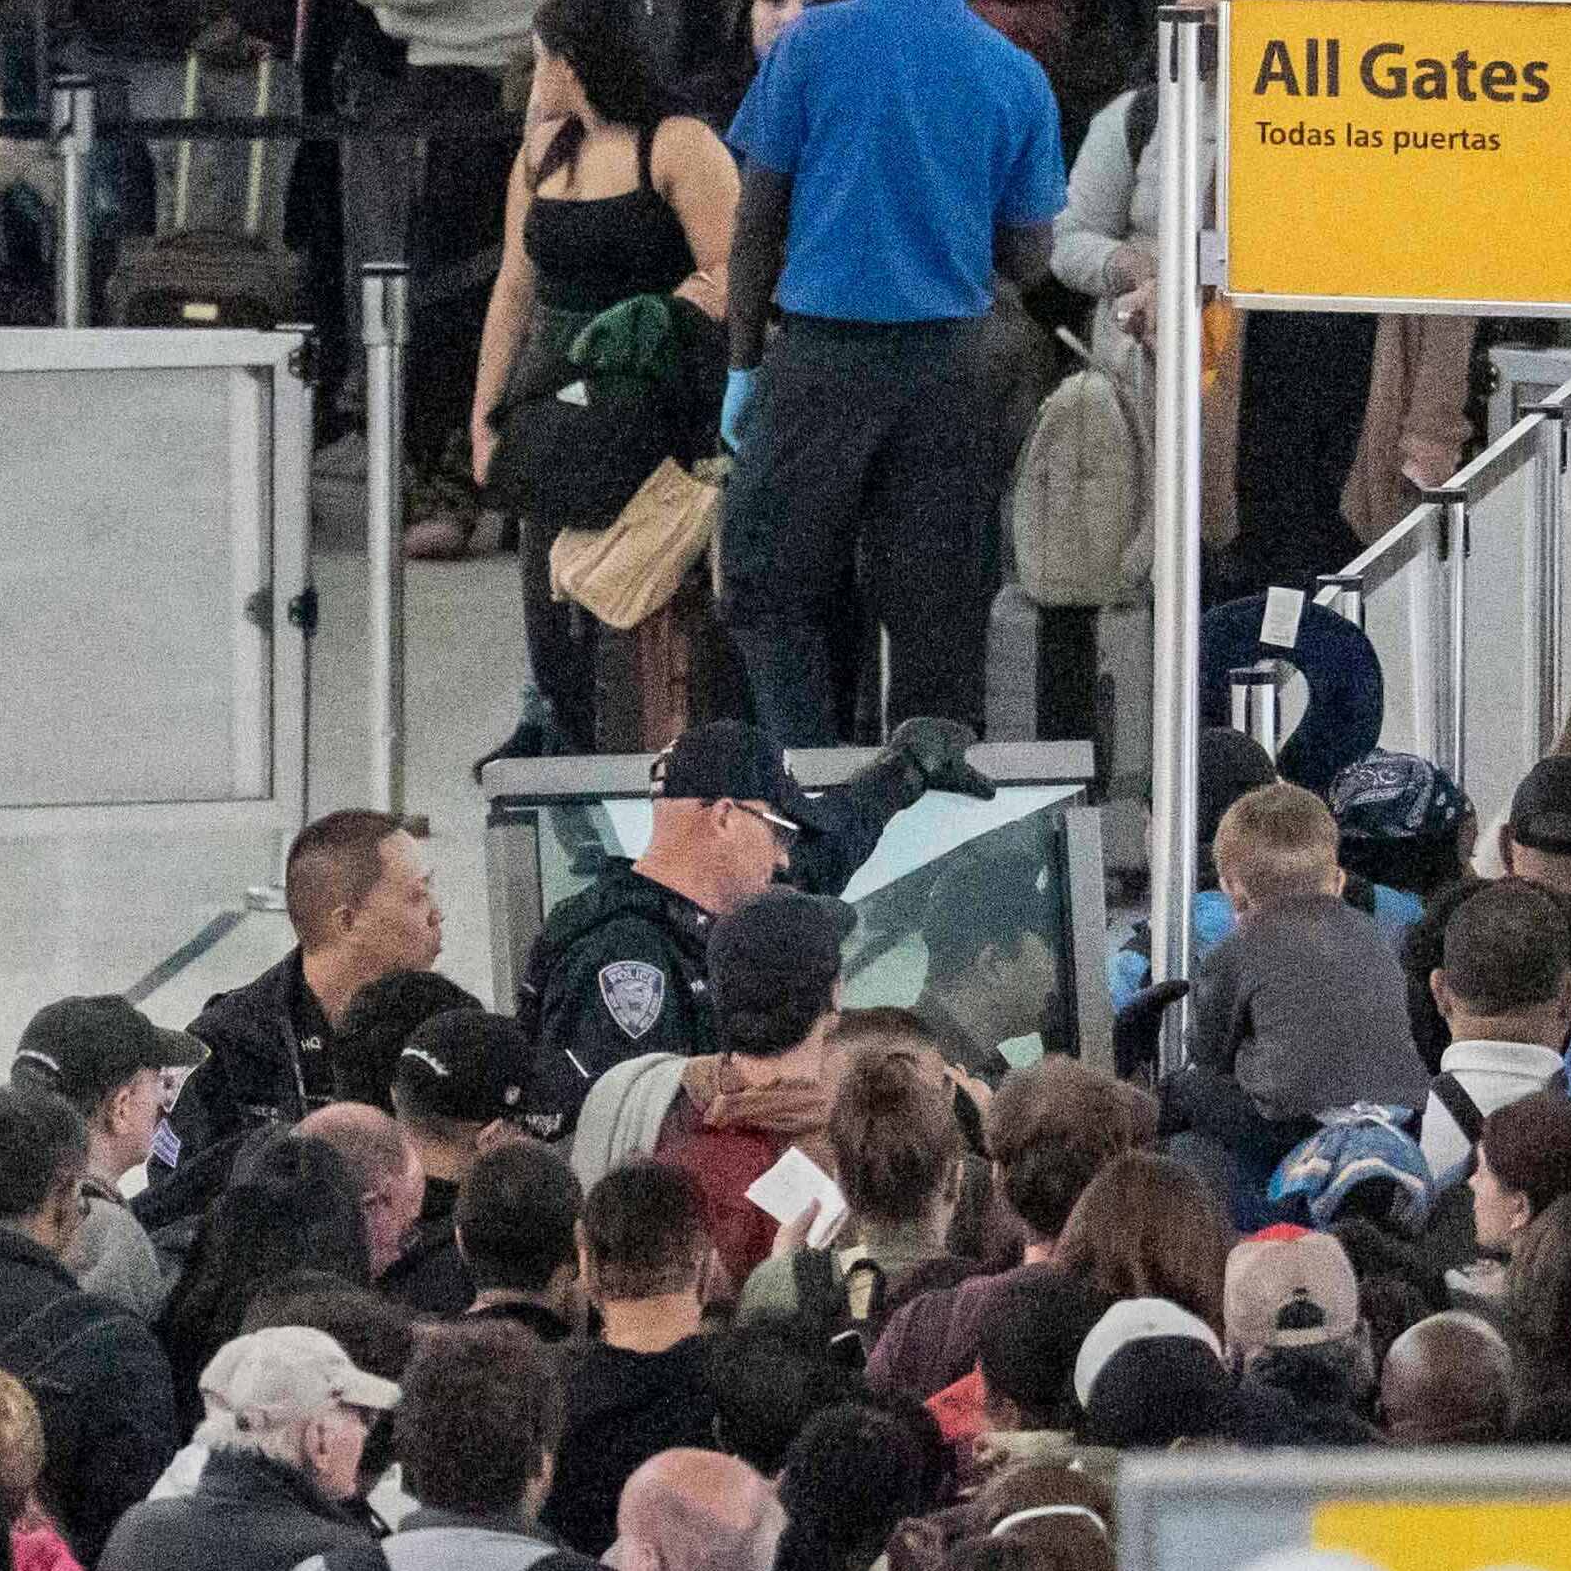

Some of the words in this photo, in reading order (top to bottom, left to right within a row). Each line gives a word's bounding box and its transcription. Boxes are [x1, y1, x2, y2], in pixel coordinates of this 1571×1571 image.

[1254, 39, 1339, 97] All
[1360, 43, 1550, 103] Gates
[1257, 121, 1335, 146] Todas
[1346, 123, 1383, 148] las
[1394, 130, 1500, 154] puertas
[608, 963, 659, 984] POLICE
